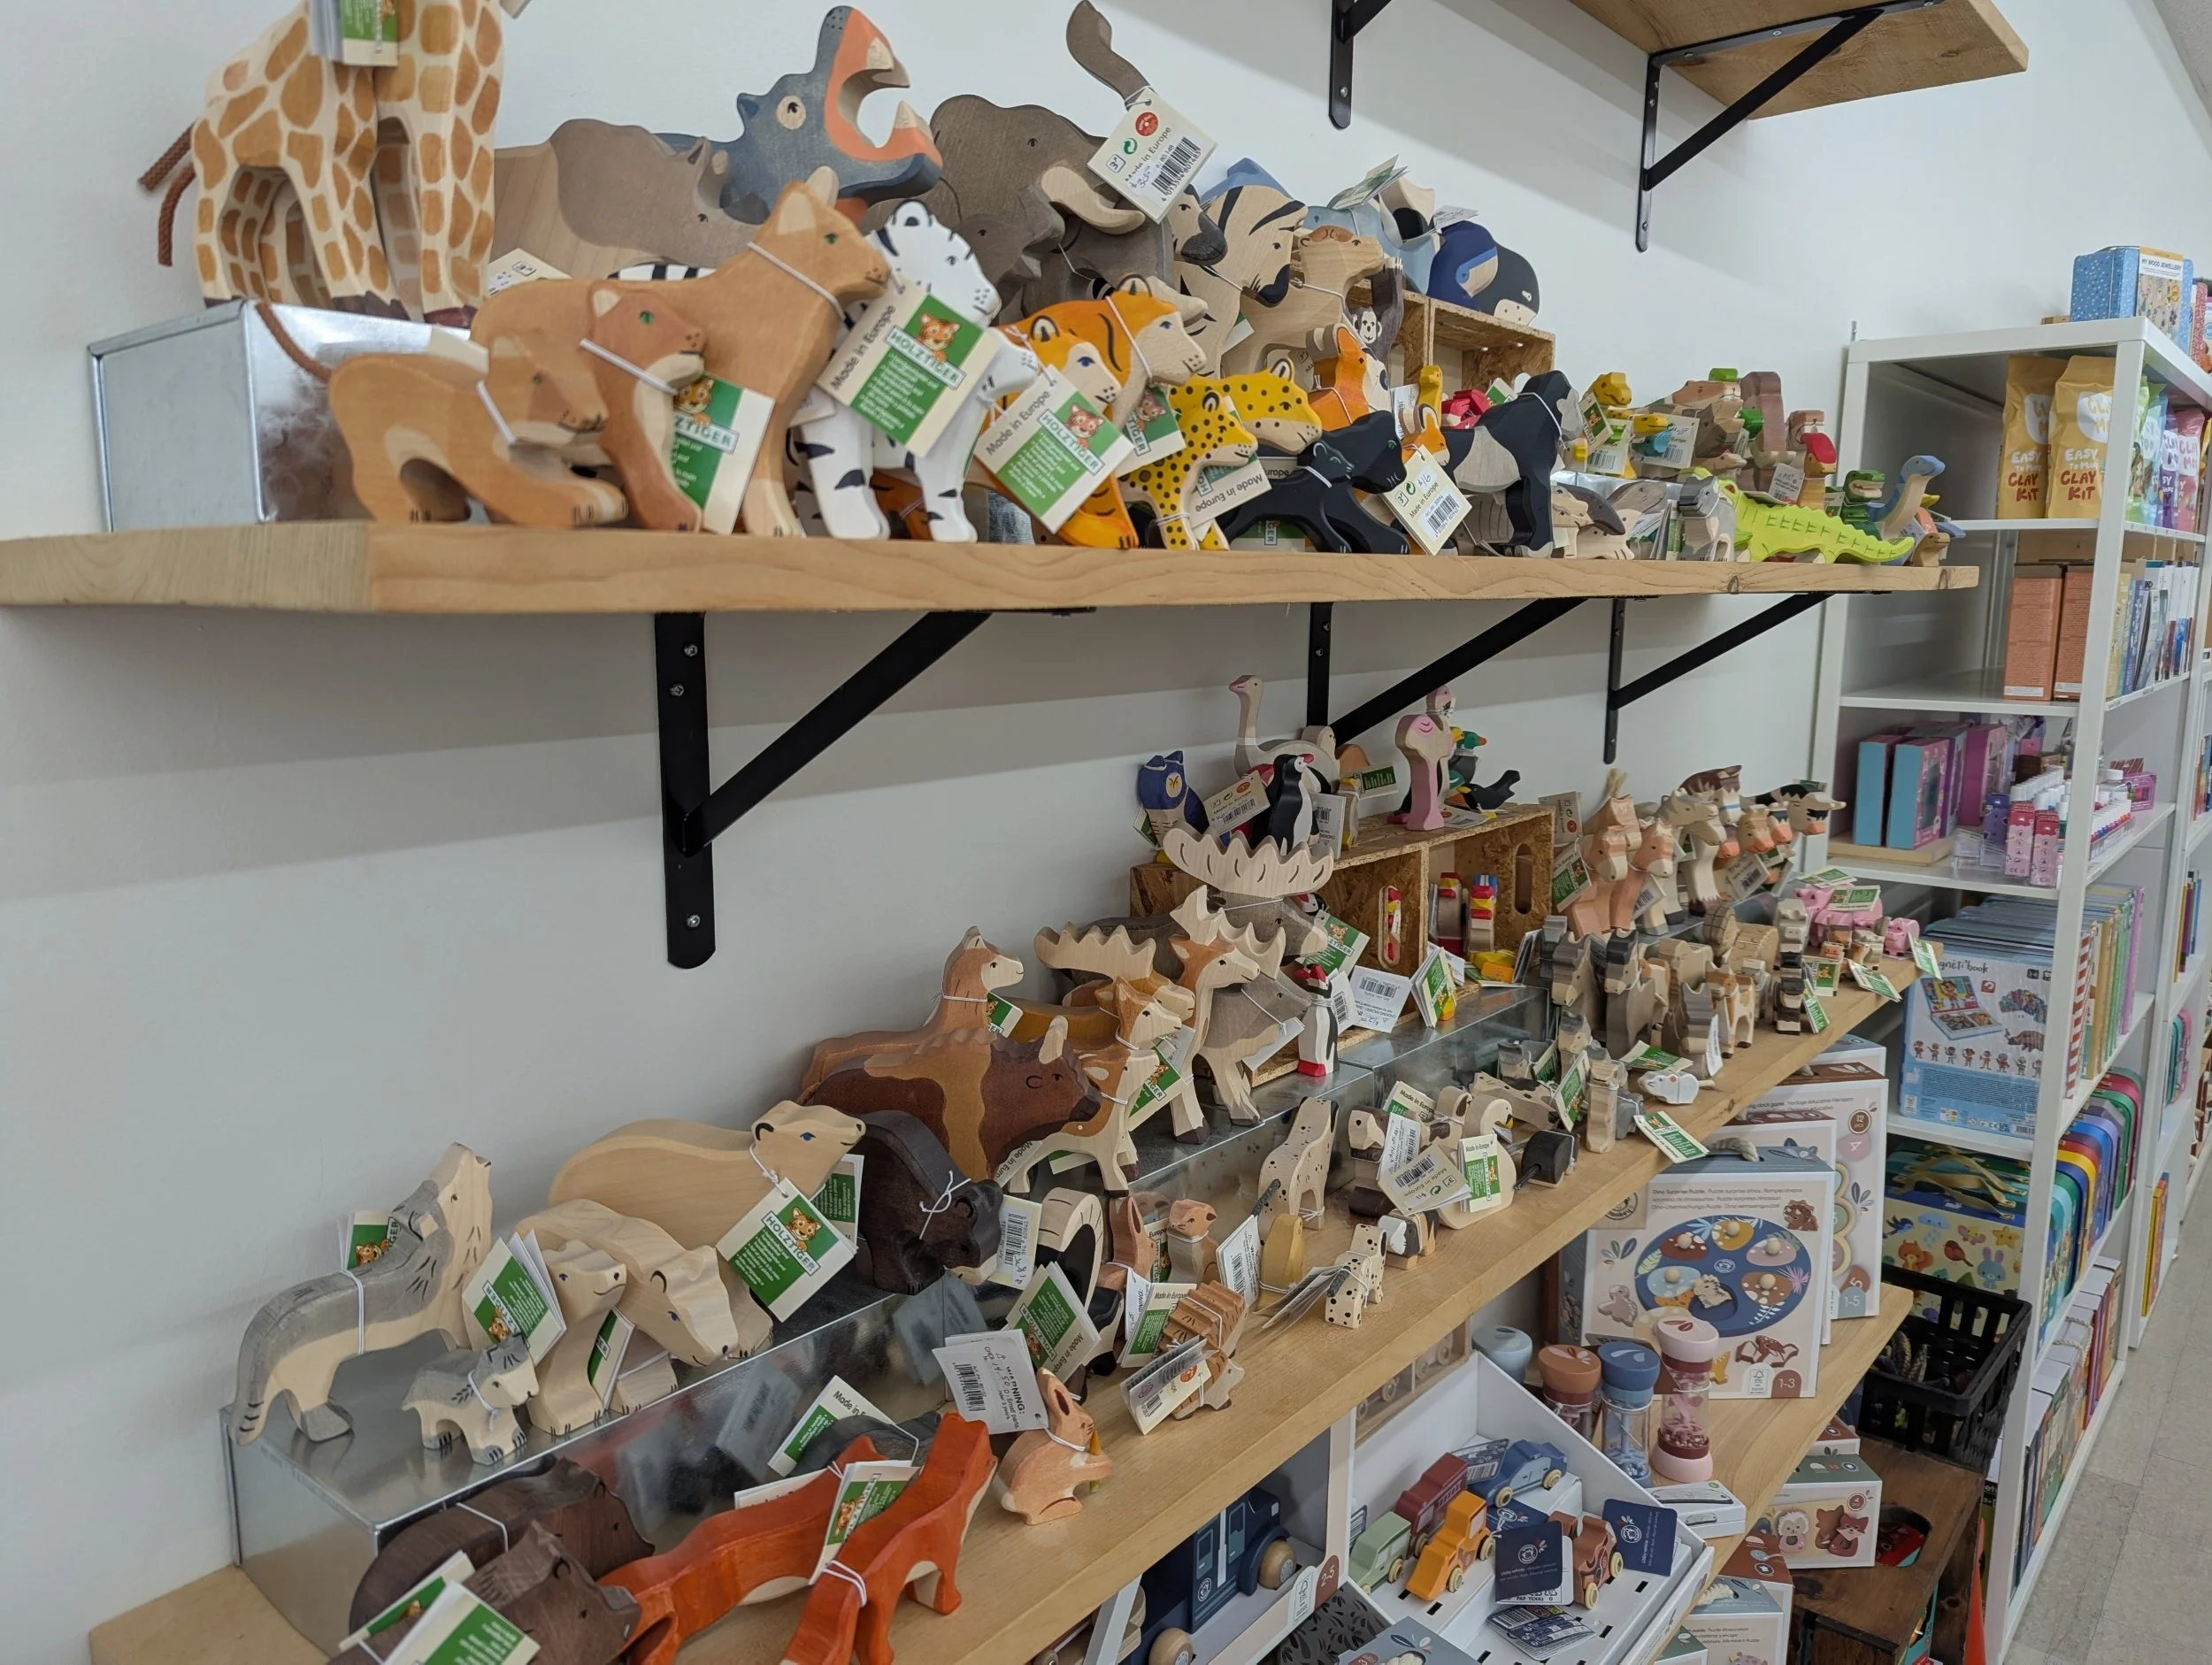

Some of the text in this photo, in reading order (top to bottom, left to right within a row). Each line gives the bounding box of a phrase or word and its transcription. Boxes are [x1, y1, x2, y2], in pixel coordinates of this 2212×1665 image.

[1148, 127, 1171, 154] Europe
[2161, 262, 2182, 271] JEWELLERY
[830, 305, 896, 390] Made in Europe
[890, 331, 960, 383] HOLZTIGER
[675, 417, 733, 447] ZTIGER
[986, 390, 1050, 456] Made in Europe
[1041, 413, 1102, 471] HOLZTIGER
[1126, 418, 1147, 453] TIGER
[2011, 451, 2041, 464] EASY
[2064, 449, 2099, 461] EASY
[1264, 470, 1290, 479] urope
[2008, 472, 2039, 487] CLAY
[2060, 470, 2097, 485] CLAY
[1195, 473, 1263, 512] Made in Europe
[1409, 505, 1422, 519] Made
[1423, 481, 1439, 501] Europe
[1328, 939, 1352, 955] ZTIGER
[1401, 1089, 1415, 1101] Made
[1419, 1101, 1436, 1115] Europe
[1850, 1141, 1862, 1152] 4
[1423, 1178, 1432, 1187] in
[1434, 1167, 1448, 1180] Made
[1403, 1183, 1425, 1197] Europe
[1149, 1226, 1167, 1238] Europe
[765, 1215, 816, 1272] HOLZTIGER
[1171, 1292, 1188, 1301] Europe
[1844, 1295, 1860, 1308] 1-5
[486, 1285, 520, 1334] LZTIGER
[1022, 1307, 1056, 1359] HOLZTIGER
[1069, 1332, 1084, 1353] Made
[1050, 1354, 1068, 1375] Europ
[1064, 1349, 1072, 1360] in
[1779, 1378, 1795, 1388] 1-3
[833, 1390, 860, 1416] Made in
[1321, 1565, 1335, 1587] 2-5
